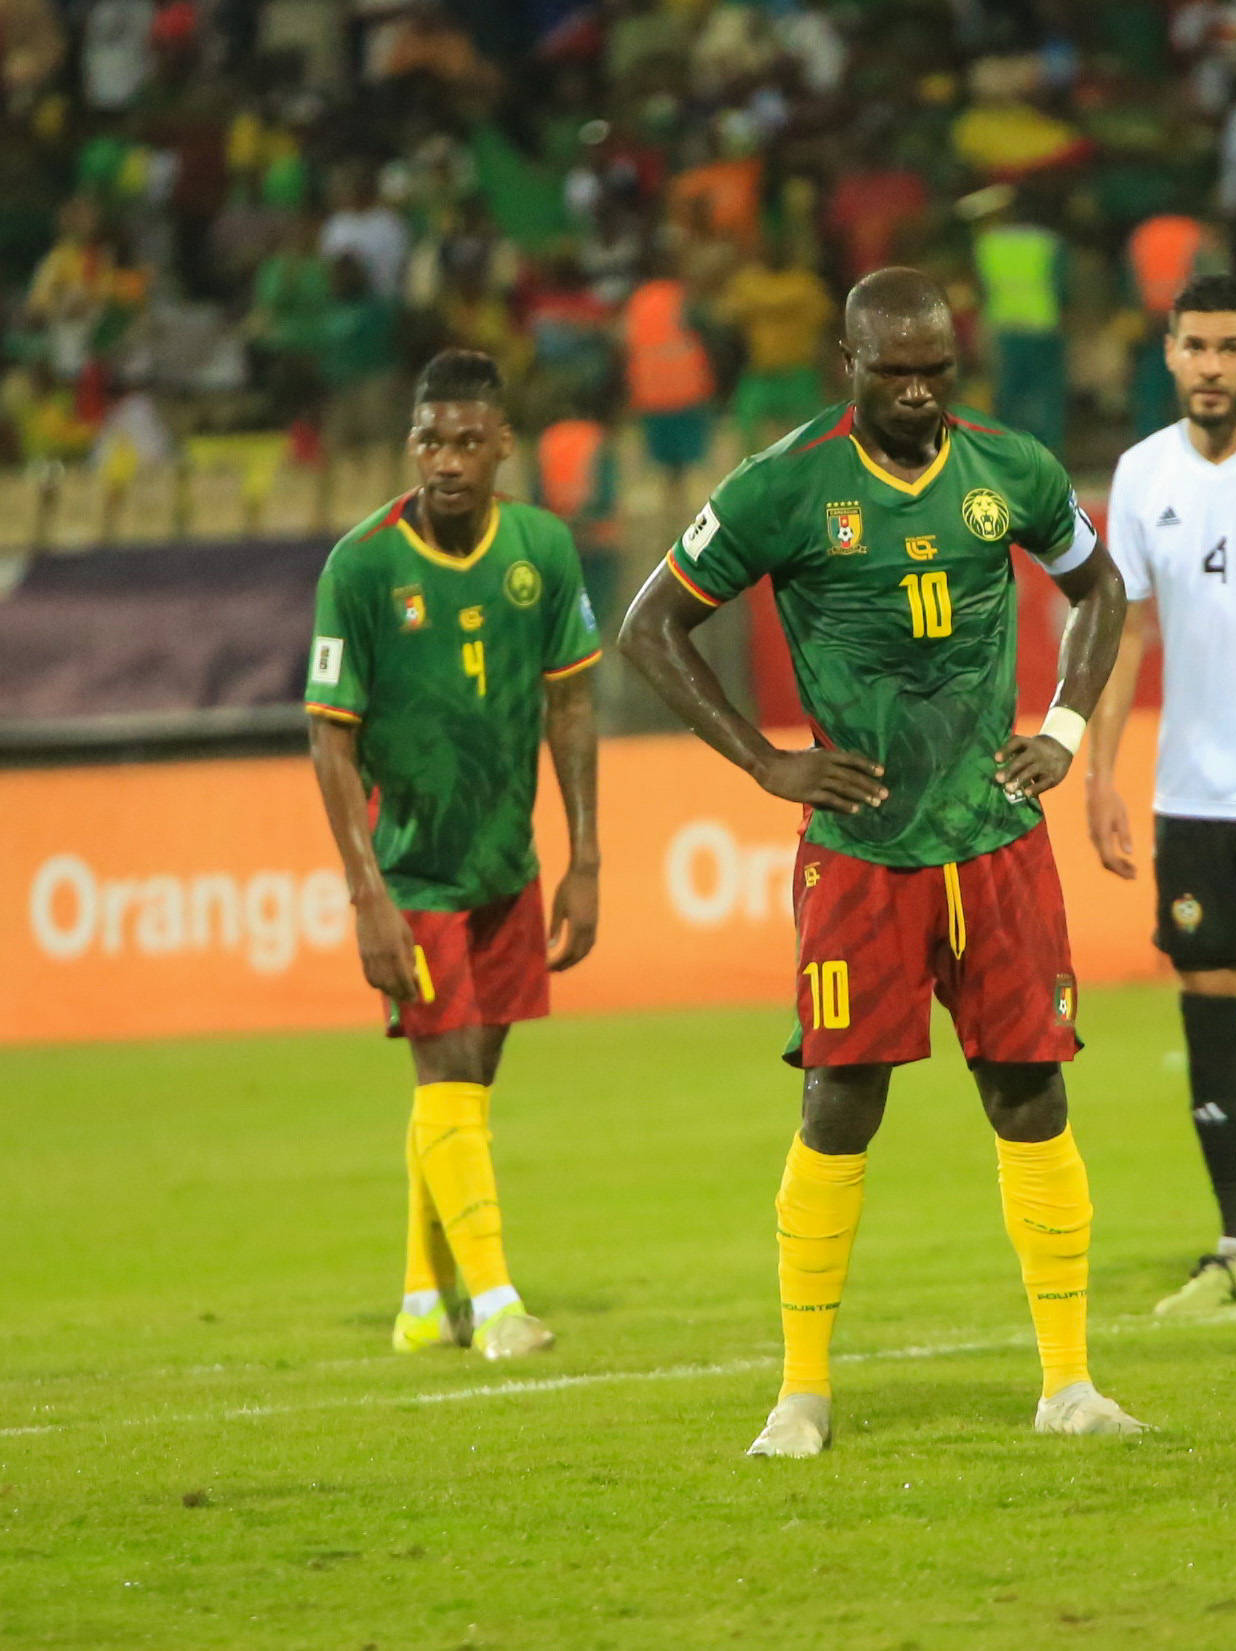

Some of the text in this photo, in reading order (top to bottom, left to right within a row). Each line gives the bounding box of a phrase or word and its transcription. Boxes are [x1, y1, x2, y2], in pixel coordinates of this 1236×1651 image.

[1203, 536, 1227, 583] 4
[899, 571, 952, 638] 10
[463, 640, 486, 697] 4
[28, 851, 353, 973] Orange
[803, 960, 850, 1030] 10
